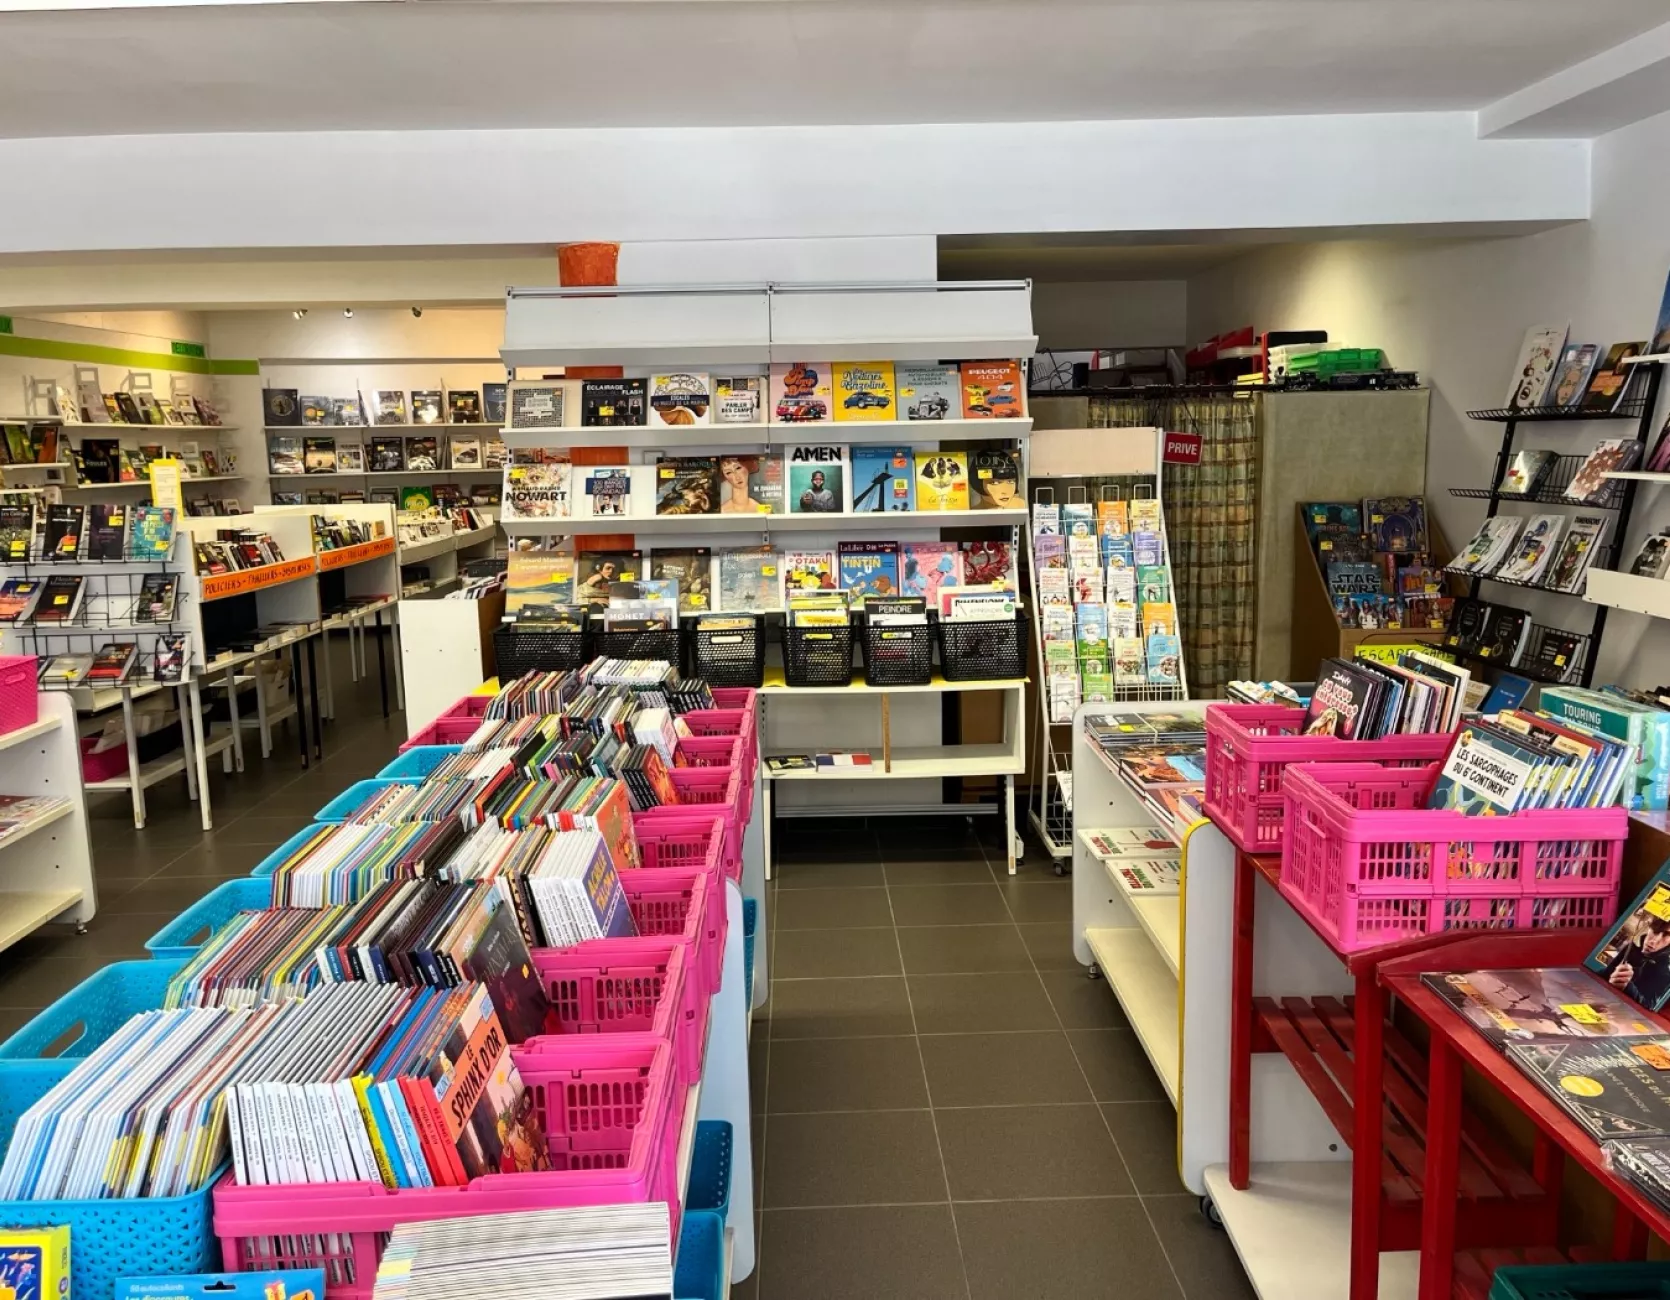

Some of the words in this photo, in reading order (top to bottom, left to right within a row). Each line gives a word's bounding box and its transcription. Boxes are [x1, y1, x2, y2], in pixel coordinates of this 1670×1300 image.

[792, 446, 842, 462] AMEN
[1167, 441, 1198, 456] PRIVE
[505, 491, 568, 502] NOWART
[795, 557, 828, 565] OTAKU
[842, 557, 881, 568] TINTIN
[1331, 574, 1380, 584] STAR
[1332, 584, 1380, 594] WARS
[878, 604, 912, 614] PEINDRE
[1563, 703, 1602, 724] TOURING
[1456, 747, 1470, 761] LES
[1470, 754, 1519, 786] SARCOPHAGES
[1453, 762, 1464, 775] DU
[1470, 770, 1510, 798] CONTINENT
[466, 1044, 475, 1061] LE
[451, 1057, 487, 1128] SPHINX
[480, 1026, 502, 1072] D'OR
